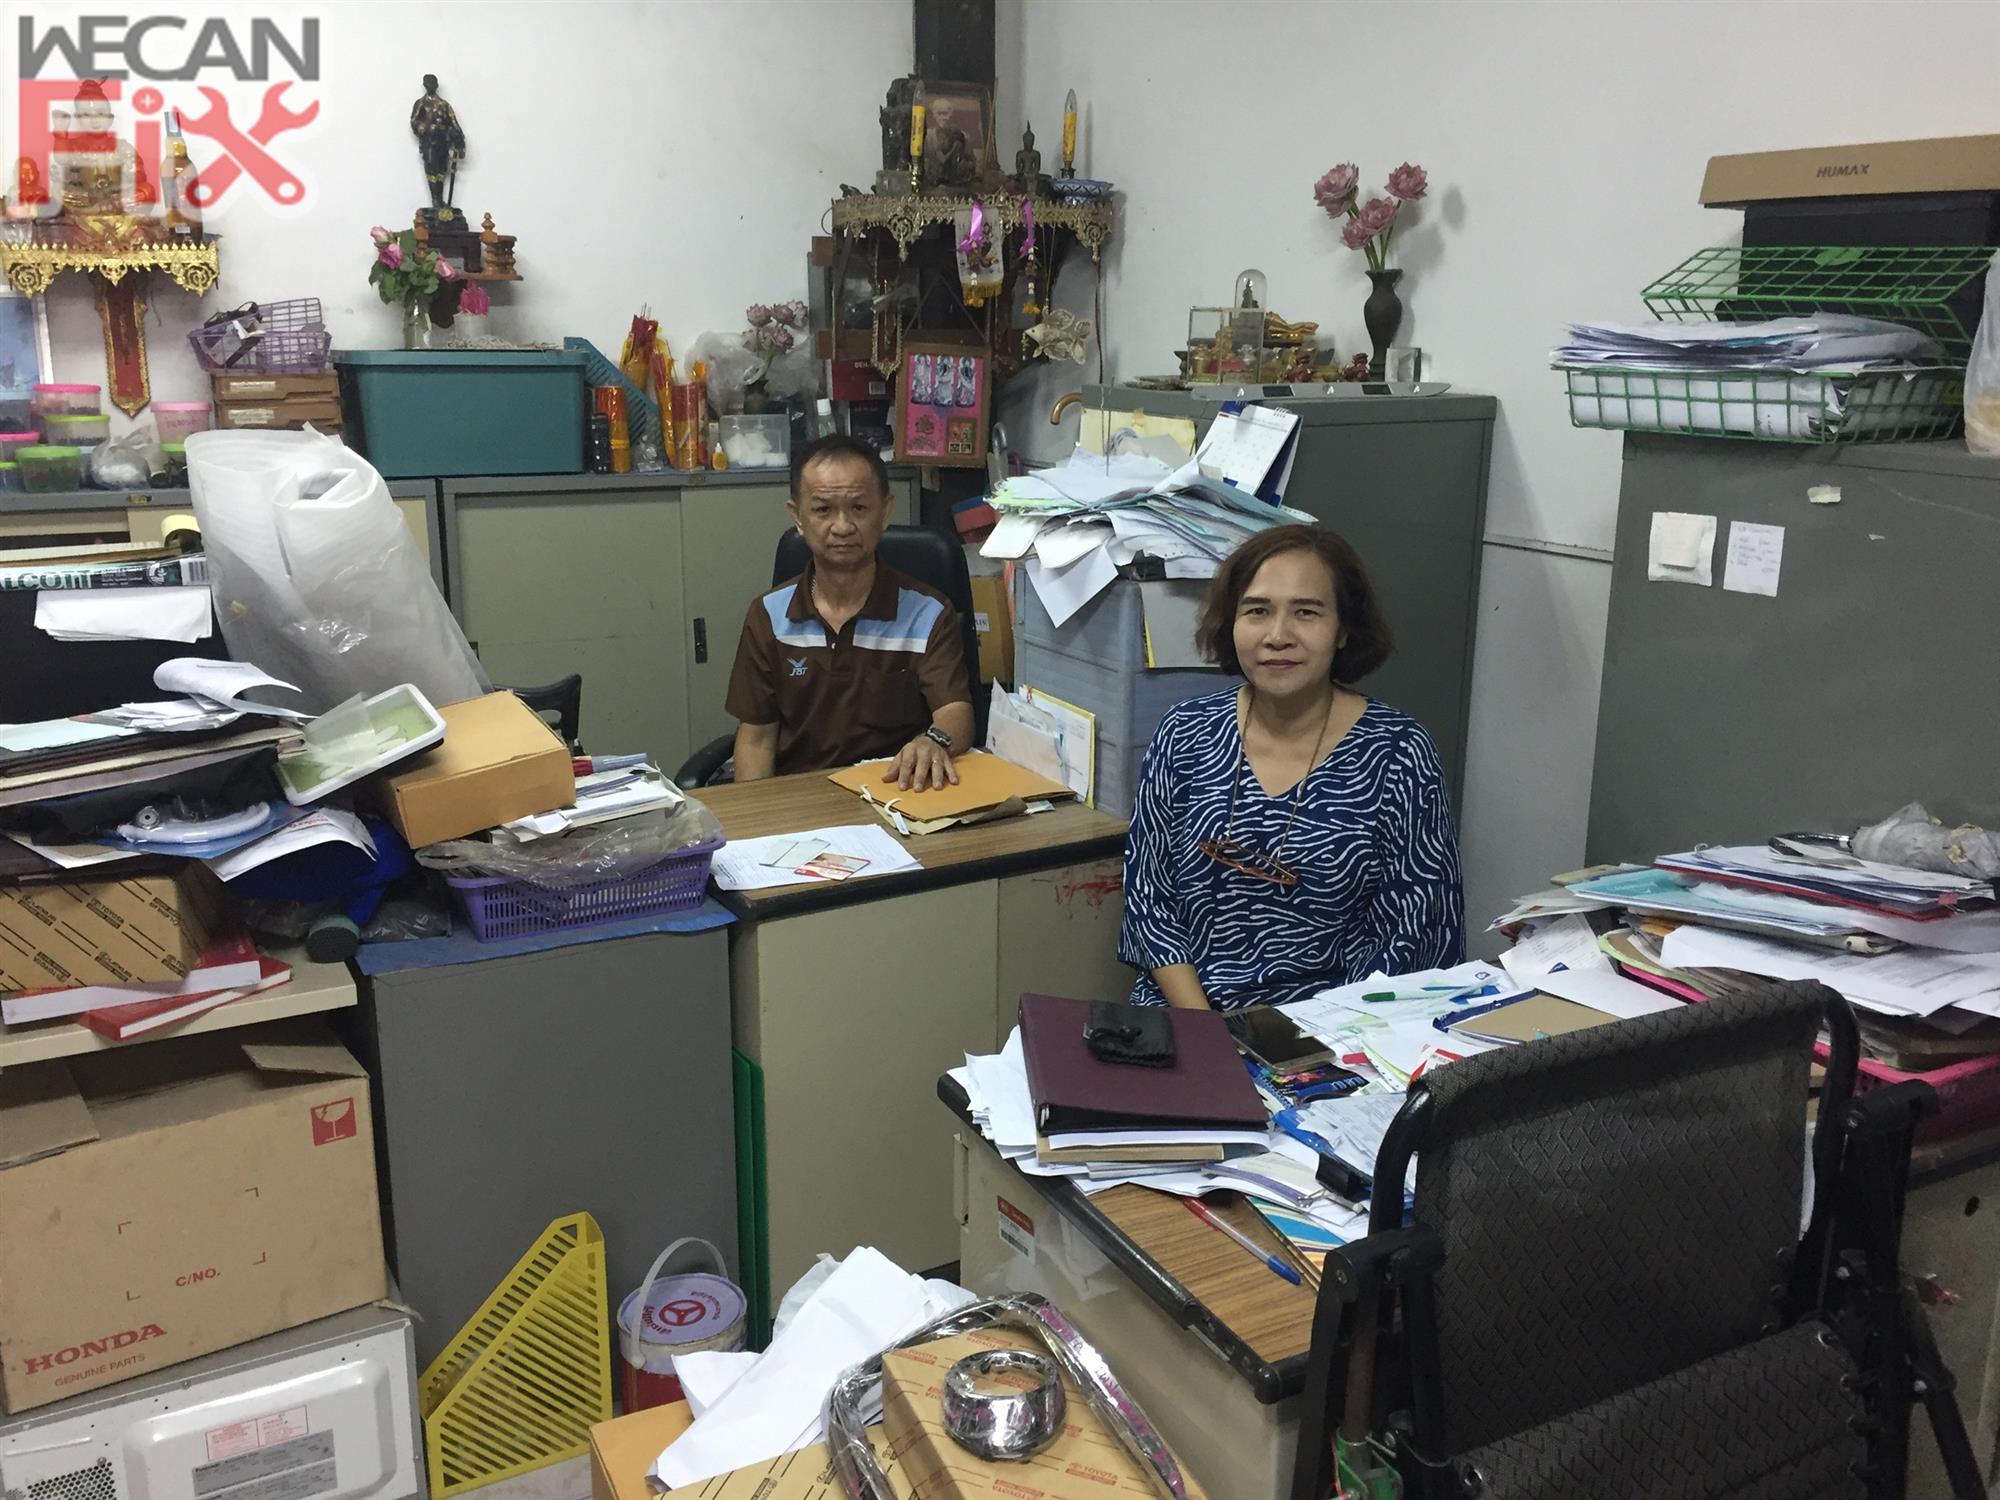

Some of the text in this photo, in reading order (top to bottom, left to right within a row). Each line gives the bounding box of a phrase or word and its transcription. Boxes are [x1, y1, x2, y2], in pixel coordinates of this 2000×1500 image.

[1816, 164, 1870, 177] HUMAX
[175, 1267, 221, 1287] C/NO.
[24, 1323, 168, 1375] HONDA
[54, 1353, 146, 1387] GENUINE PARTS
